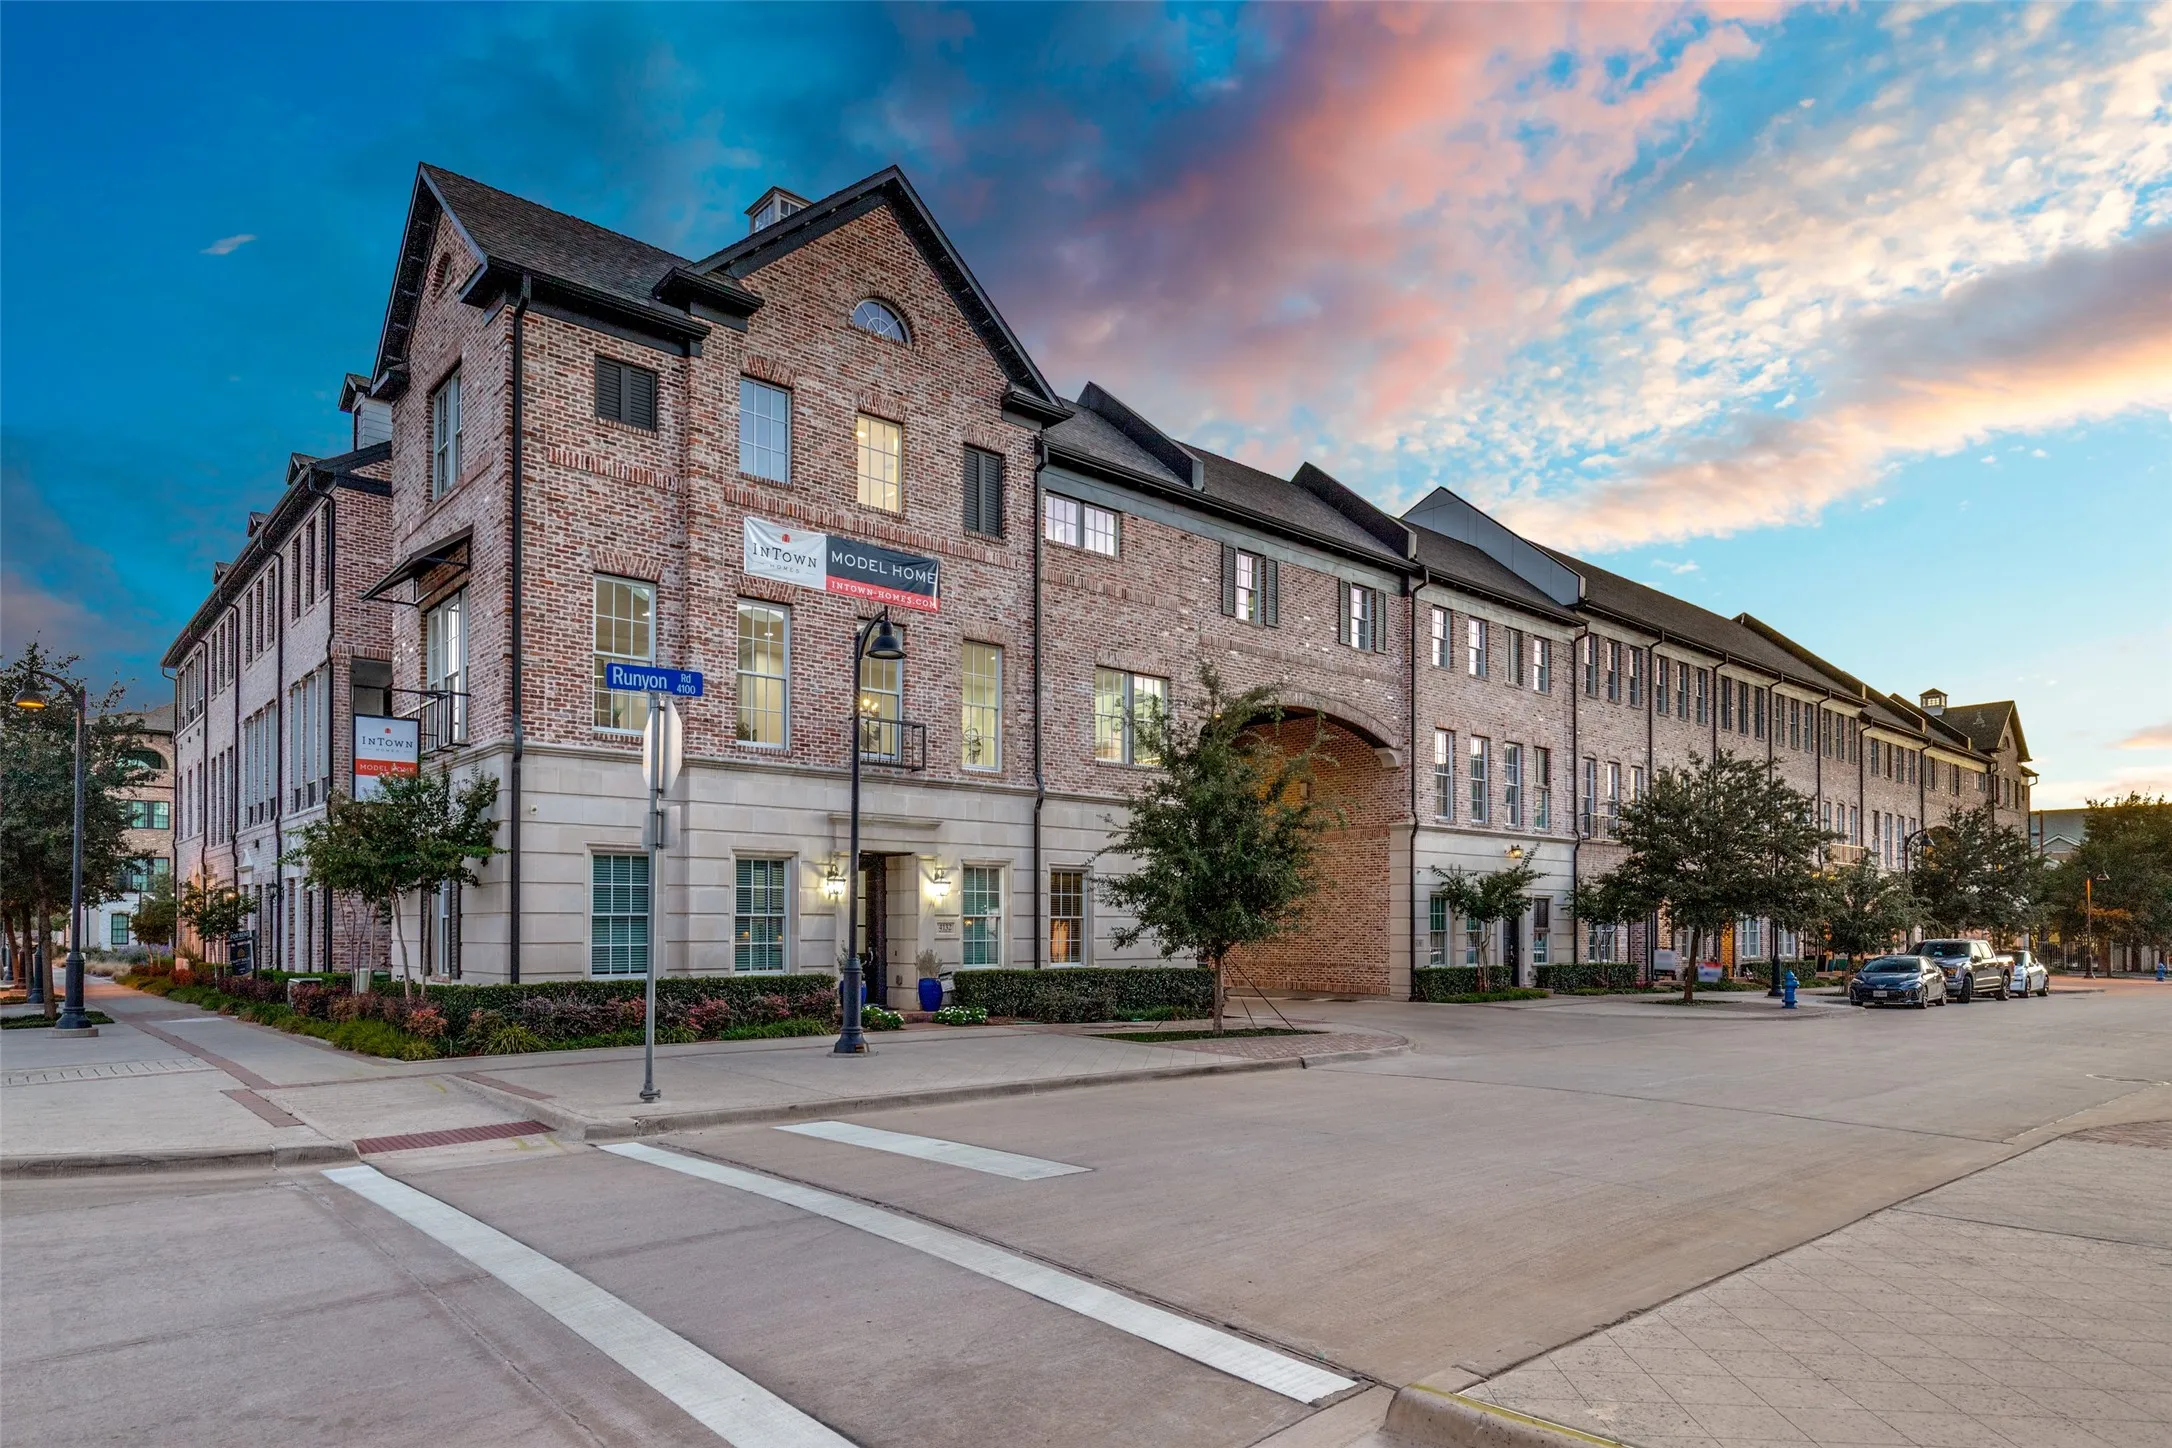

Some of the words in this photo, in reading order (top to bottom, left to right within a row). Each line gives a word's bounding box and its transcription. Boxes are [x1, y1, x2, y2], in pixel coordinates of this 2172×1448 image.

[769, 563, 800, 574] HOMES
[831, 550, 888, 575] MODEL
[892, 564, 936, 585] HOME
[831, 581, 937, 609] INTOWN-HOMES.COM
[612, 666, 668, 690] Runyon
[680, 673, 691, 684] Rd
[676, 684, 696, 695] 4100
[359, 764, 389, 772] MODEL
